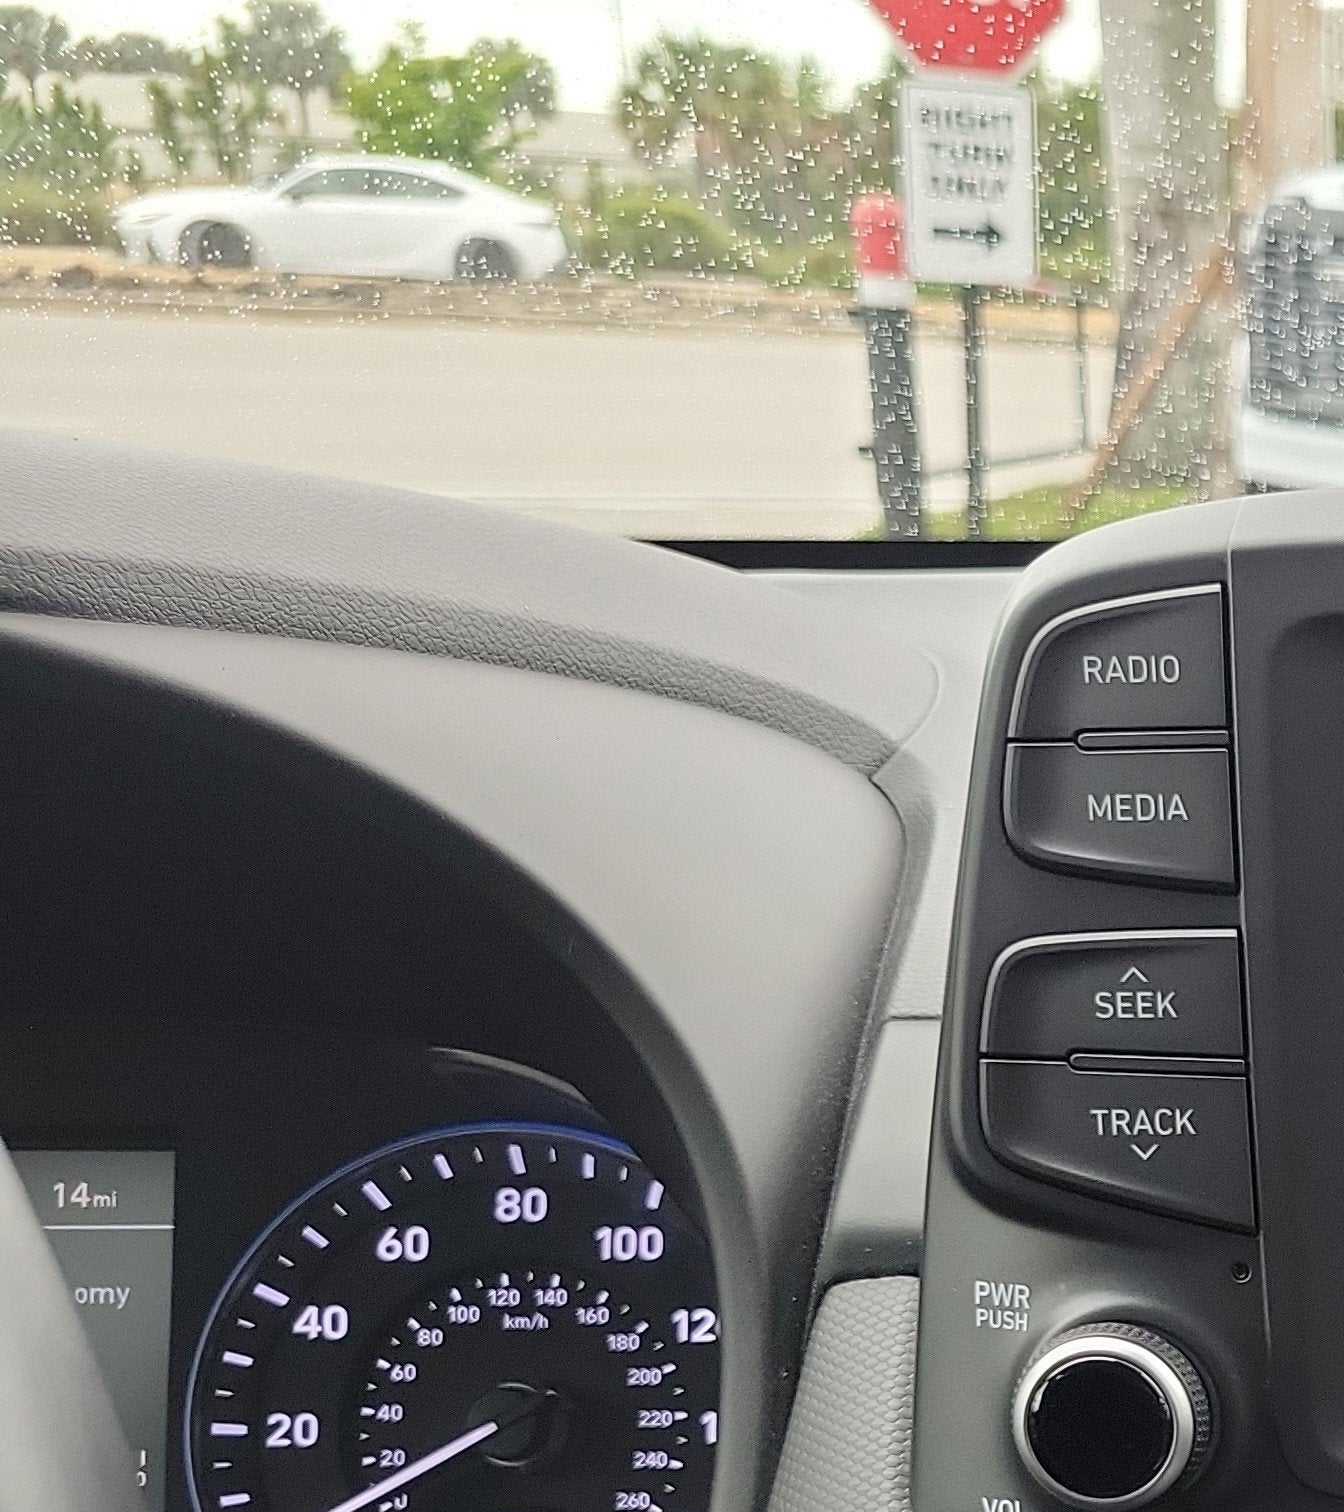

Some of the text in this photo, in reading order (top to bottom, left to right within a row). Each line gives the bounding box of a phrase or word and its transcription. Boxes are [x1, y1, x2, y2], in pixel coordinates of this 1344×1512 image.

[1082, 654, 1180, 684] RADIO
[1087, 793, 1188, 821] MEDIA
[1094, 991, 1177, 1019] SEEK
[1089, 1108, 1196, 1136] TRACK
[494, 1187, 548, 1223] 80
[376, 1225, 430, 1262] 60
[595, 1226, 664, 1261] 100
[487, 1288, 521, 1307] 120
[534, 1288, 568, 1308] 140
[974, 1280, 1030, 1309] PWR
[292, 1304, 349, 1340] 40
[447, 1305, 481, 1324] 100
[502, 1312, 549, 1330] km/h
[575, 1306, 610, 1325] 160
[975, 1308, 1029, 1332] PUSH
[668, 1304, 721, 1346] 12
[416, 1327, 445, 1348] 80
[607, 1332, 641, 1352] 180
[389, 1363, 417, 1383] 60
[627, 1367, 663, 1386] 200
[376, 1404, 403, 1422] 40
[638, 1410, 674, 1428] 220
[265, 1412, 319, 1448] 20
[379, 1449, 407, 1468] 20
[633, 1451, 669, 1469] 240
[616, 1491, 650, 1509] 260
